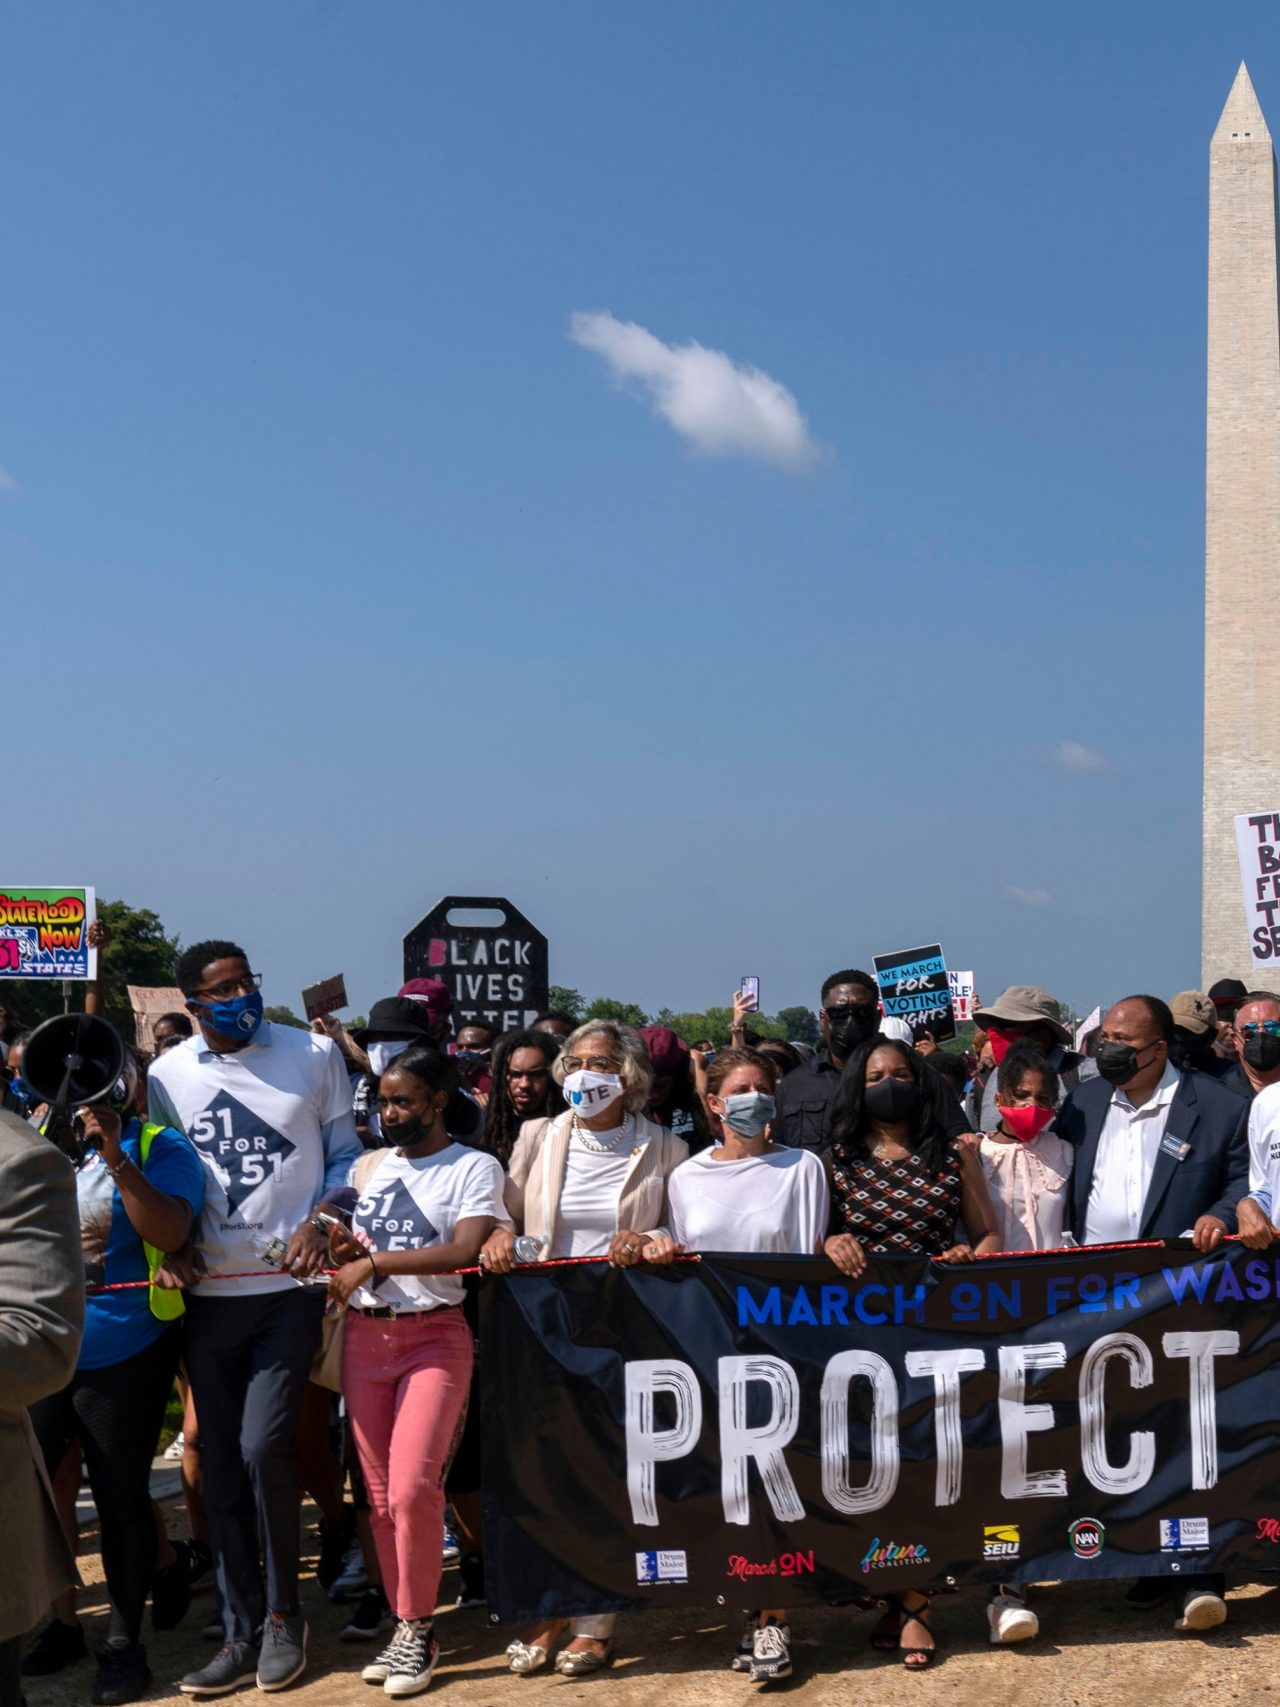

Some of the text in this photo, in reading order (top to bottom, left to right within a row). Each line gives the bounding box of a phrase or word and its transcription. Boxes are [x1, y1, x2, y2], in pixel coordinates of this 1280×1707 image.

[428, 938, 531, 966] BLACK
[880, 961, 943, 981] WE MARCH
[456, 973, 524, 1001] IVES
[896, 975, 935, 995] FOR
[886, 992, 949, 1012] VOTING
[902, 1006, 948, 1028] IGHTS
[193, 1107, 233, 1143] 51
[219, 1136, 267, 1155] FOR
[239, 1152, 283, 1186] 51
[356, 1191, 396, 1218] 51
[371, 1218, 414, 1233] FOR
[736, 1282, 926, 1327] MARCH
[951, 1282, 1022, 1322] ON
[1047, 1272, 1141, 1317] FOR
[624, 1330, 1240, 1528] PROTECT
[983, 1543, 1020, 1556] SEIU
[1075, 1532, 1098, 1545] NAN
[860, 1537, 928, 1573] future
[871, 1557, 931, 1569] COALITION
[726, 1554, 778, 1582] March
